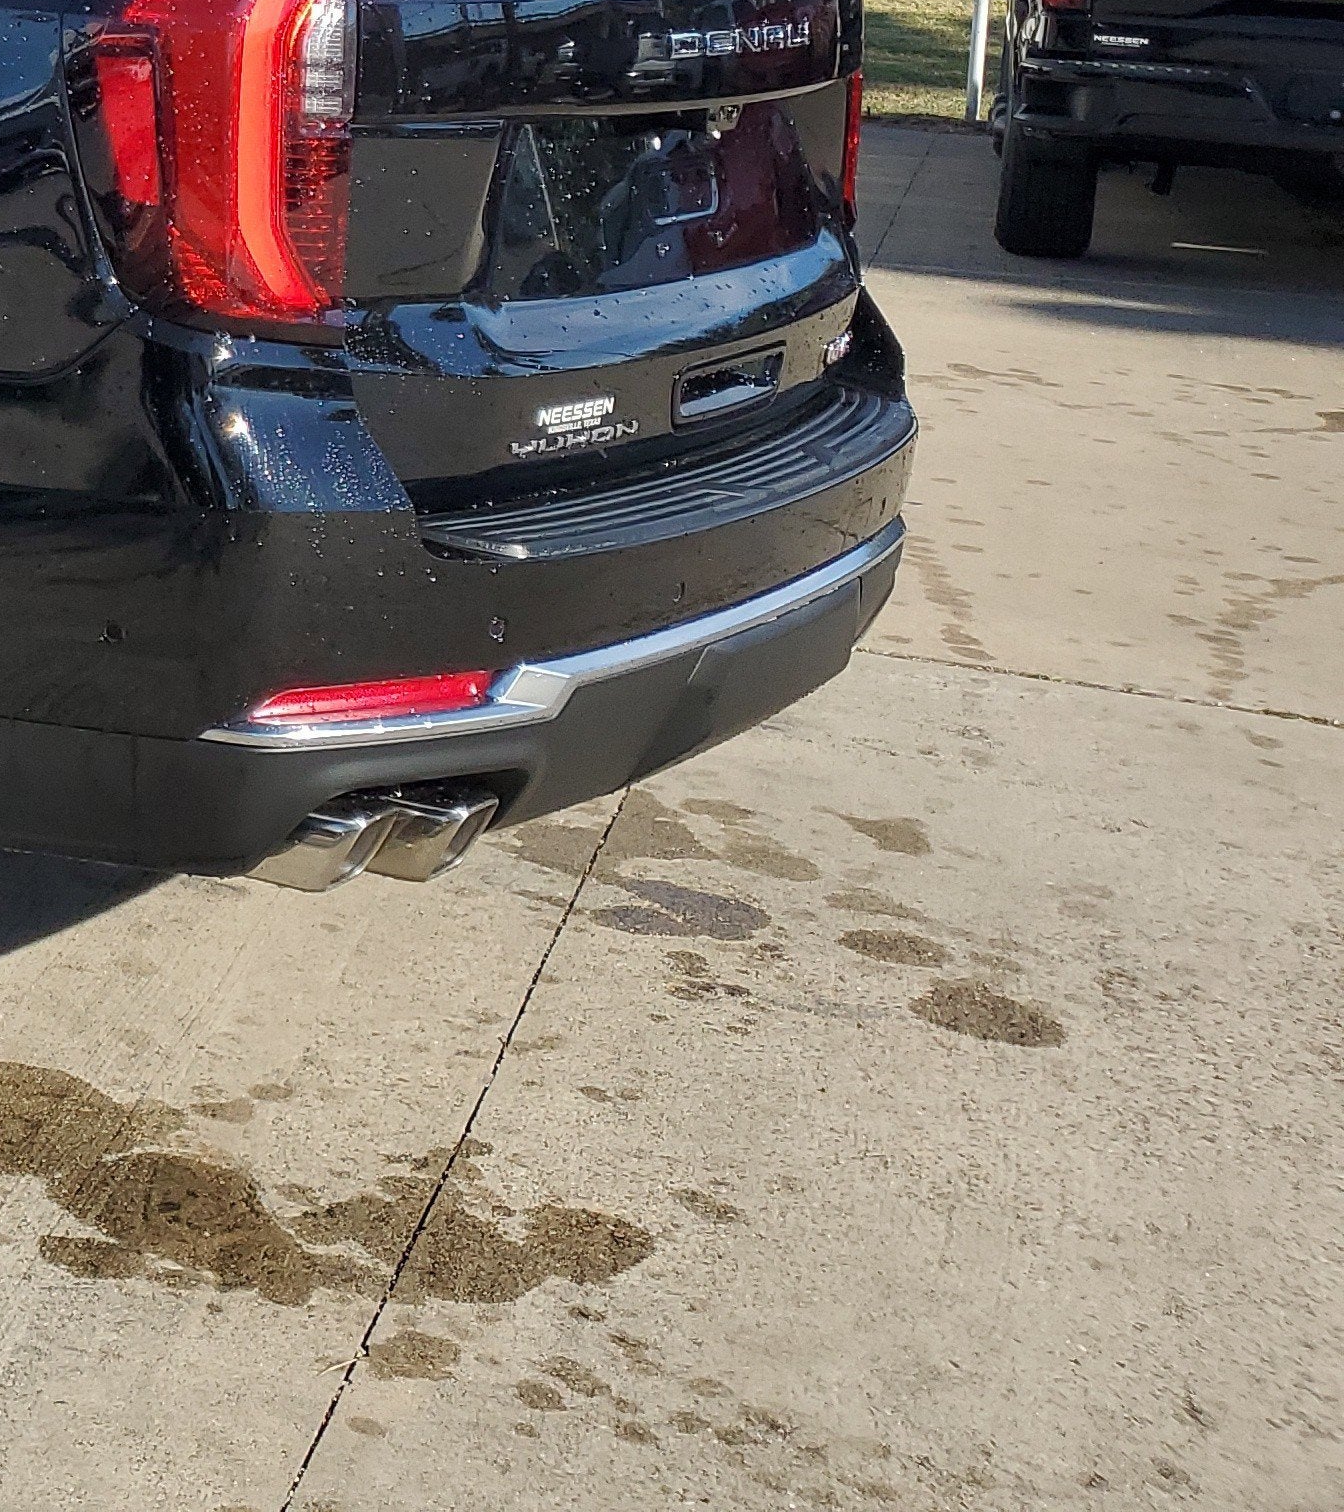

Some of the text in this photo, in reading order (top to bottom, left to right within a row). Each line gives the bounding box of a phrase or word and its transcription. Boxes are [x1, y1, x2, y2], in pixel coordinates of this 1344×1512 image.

[669, 16, 810, 60] DENALI
[537, 396, 615, 427] NEESSEN
[510, 419, 639, 459] YUKON
